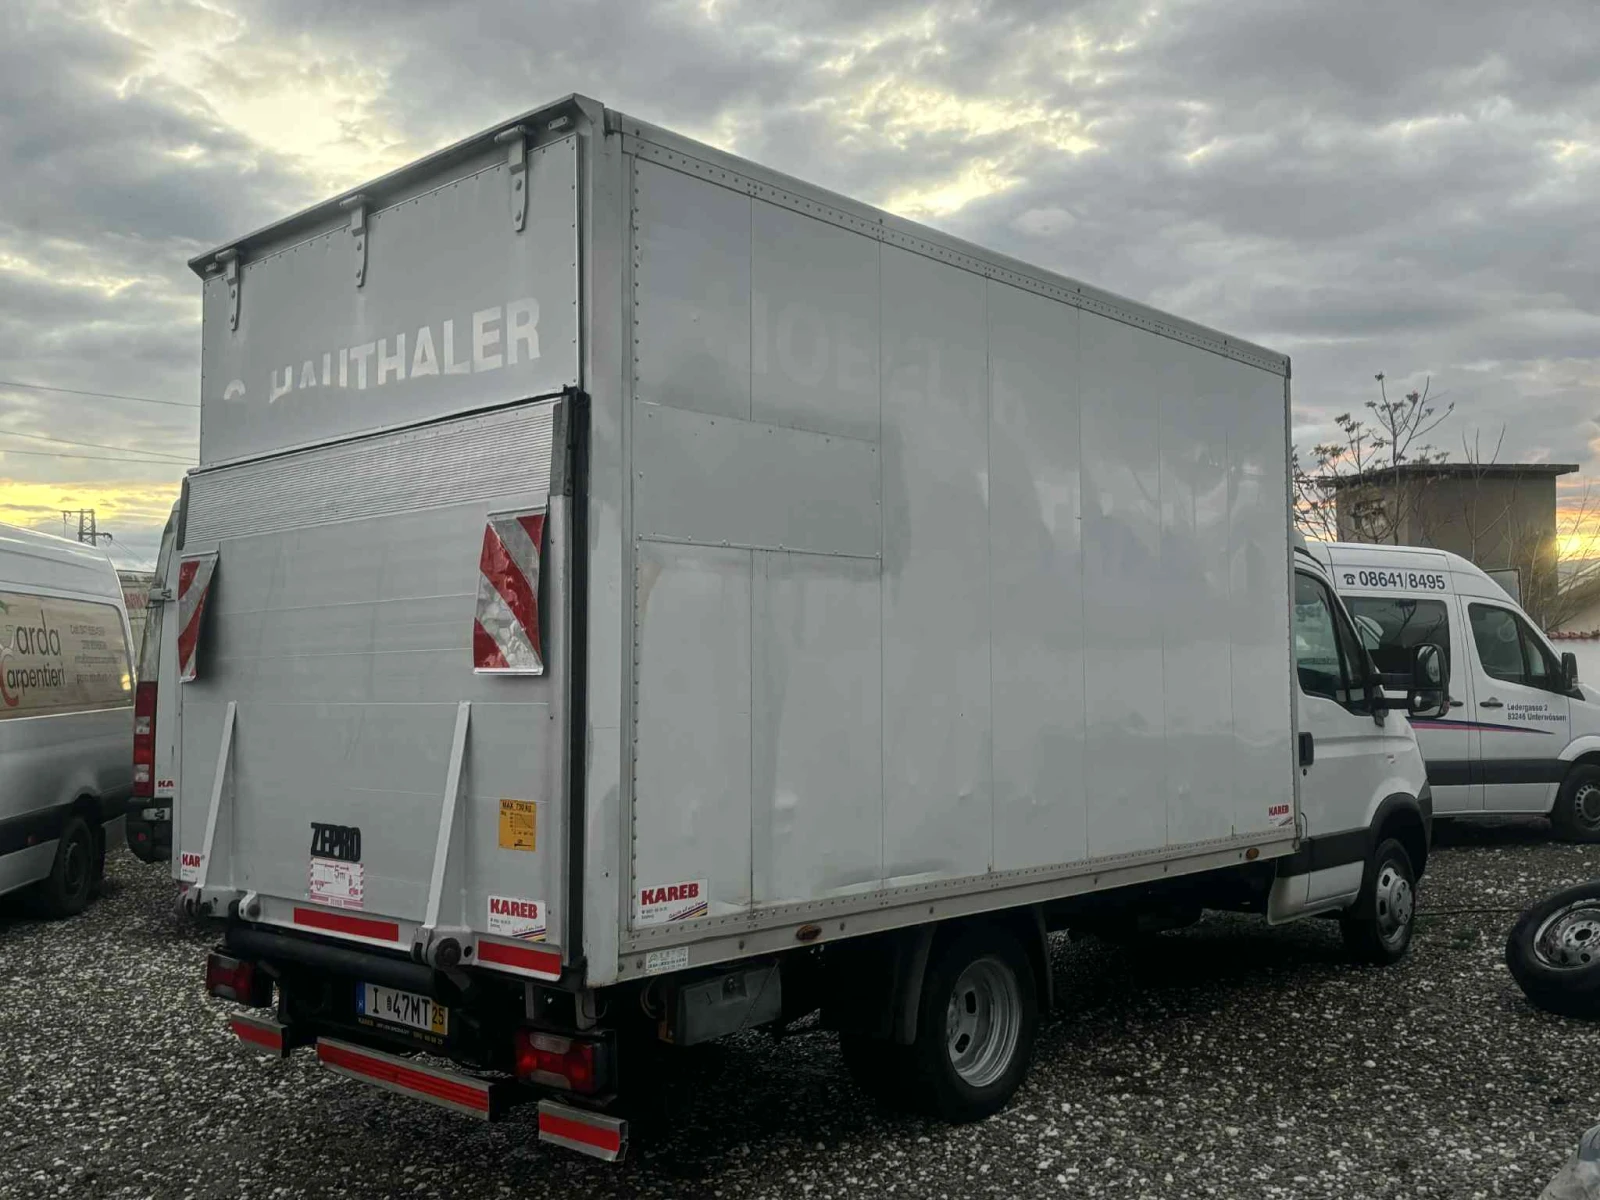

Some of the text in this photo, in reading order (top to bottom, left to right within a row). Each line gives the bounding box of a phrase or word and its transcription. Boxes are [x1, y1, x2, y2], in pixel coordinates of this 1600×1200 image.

[1358, 570, 1446, 590] 08641/8495
[310, 822, 361, 862] ZEPRO
[641, 883, 699, 906] KAREB
[490, 898, 538, 920] KAREB
[431, 1006, 445, 1026] 25
